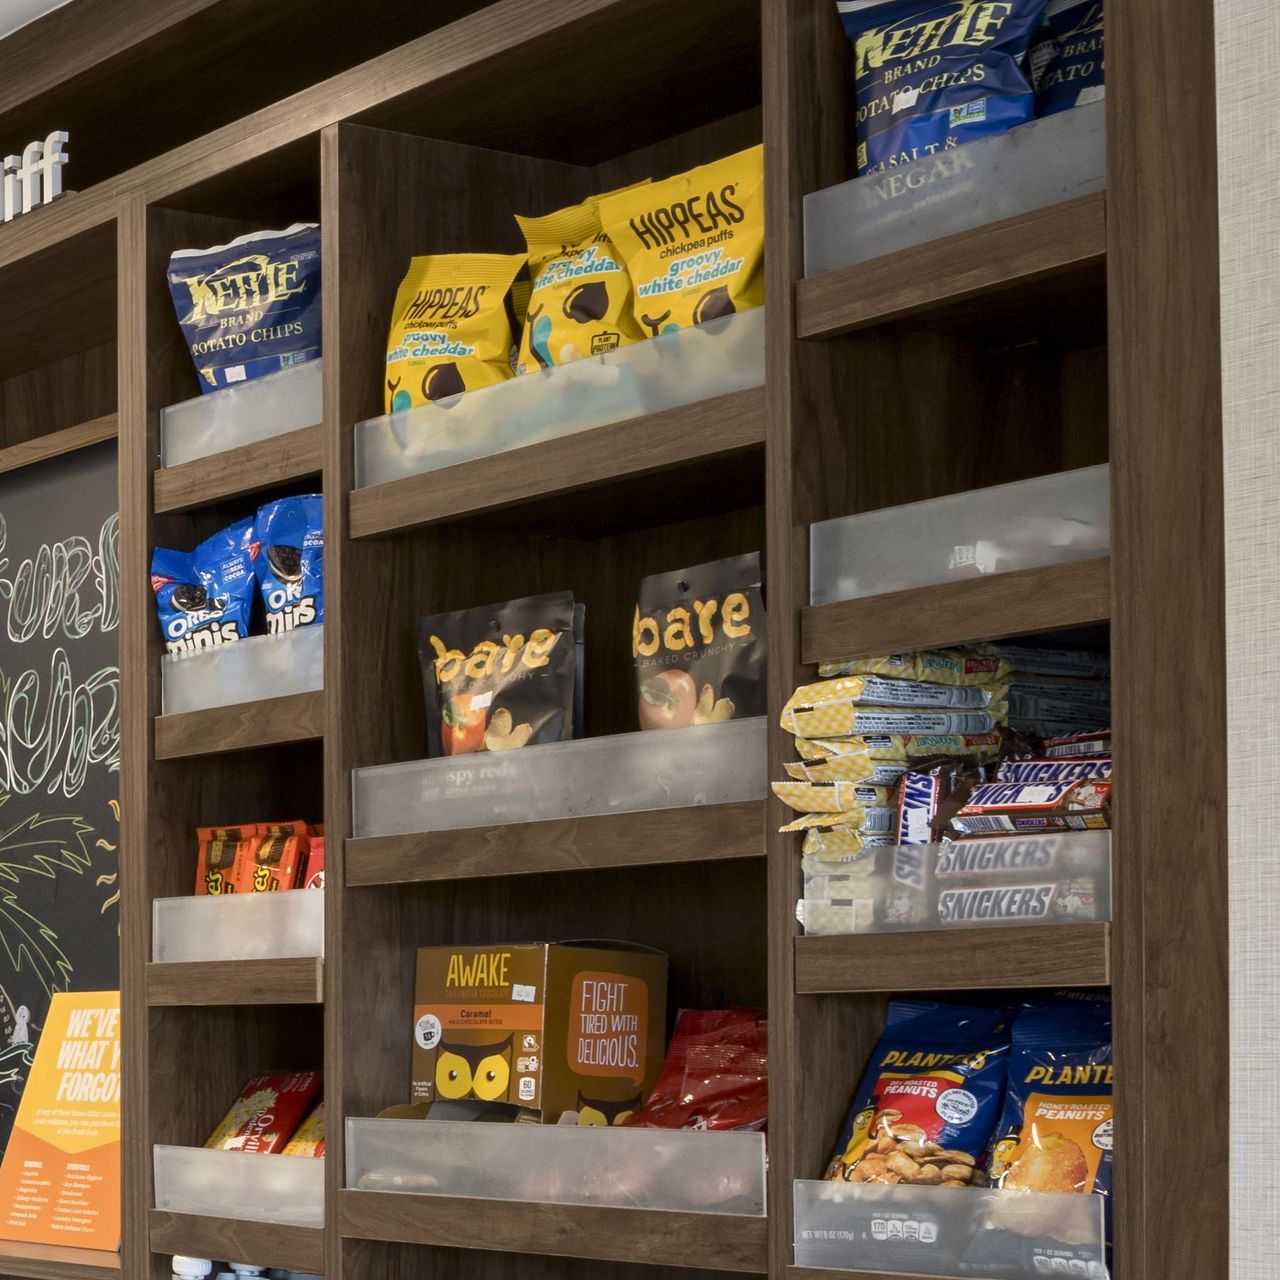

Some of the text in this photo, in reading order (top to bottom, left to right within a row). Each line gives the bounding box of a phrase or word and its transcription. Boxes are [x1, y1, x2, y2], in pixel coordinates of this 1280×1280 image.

[884, 55, 940, 84] BRAND
[919, 63, 985, 95] CHIPS
[630, 184, 745, 249] HIPPEAS
[660, 229, 734, 260] chickpea puffs
[639, 258, 743, 297] white cheddar
[669, 249, 722, 277] groovy
[181, 255, 306, 324] KETTLE
[403, 286, 486, 321] HIPPEAS
[220, 311, 263, 329] BRAND
[192, 321, 303, 356] POTATO CHIPS
[403, 333, 446, 346] groovy
[412, 342, 473, 357] cheddar
[167, 621, 239, 654] minis
[633, 592, 751, 657] bare
[430, 628, 557, 684] bare
[939, 885, 1054, 919] SNICKERS
[446, 953, 511, 987] AWAKE
[582, 981, 628, 1012] FIGHT
[66, 1008, 120, 1038] WE'VE
[460, 1010, 492, 1018] Caramel
[580, 1013, 638, 1034] TIRED WITH
[57, 1041, 109, 1069] WHAT
[578, 1034, 639, 1068] DELICIOUS.
[905, 1080, 938, 1088] ROASTED
[1025, 1066, 1112, 1085] PLANTE
[884, 1085, 938, 1099] PEANUTS
[1039, 1102, 1111, 1111] HONEY ROASTED
[1035, 1108, 1105, 1121] PEANUTS
